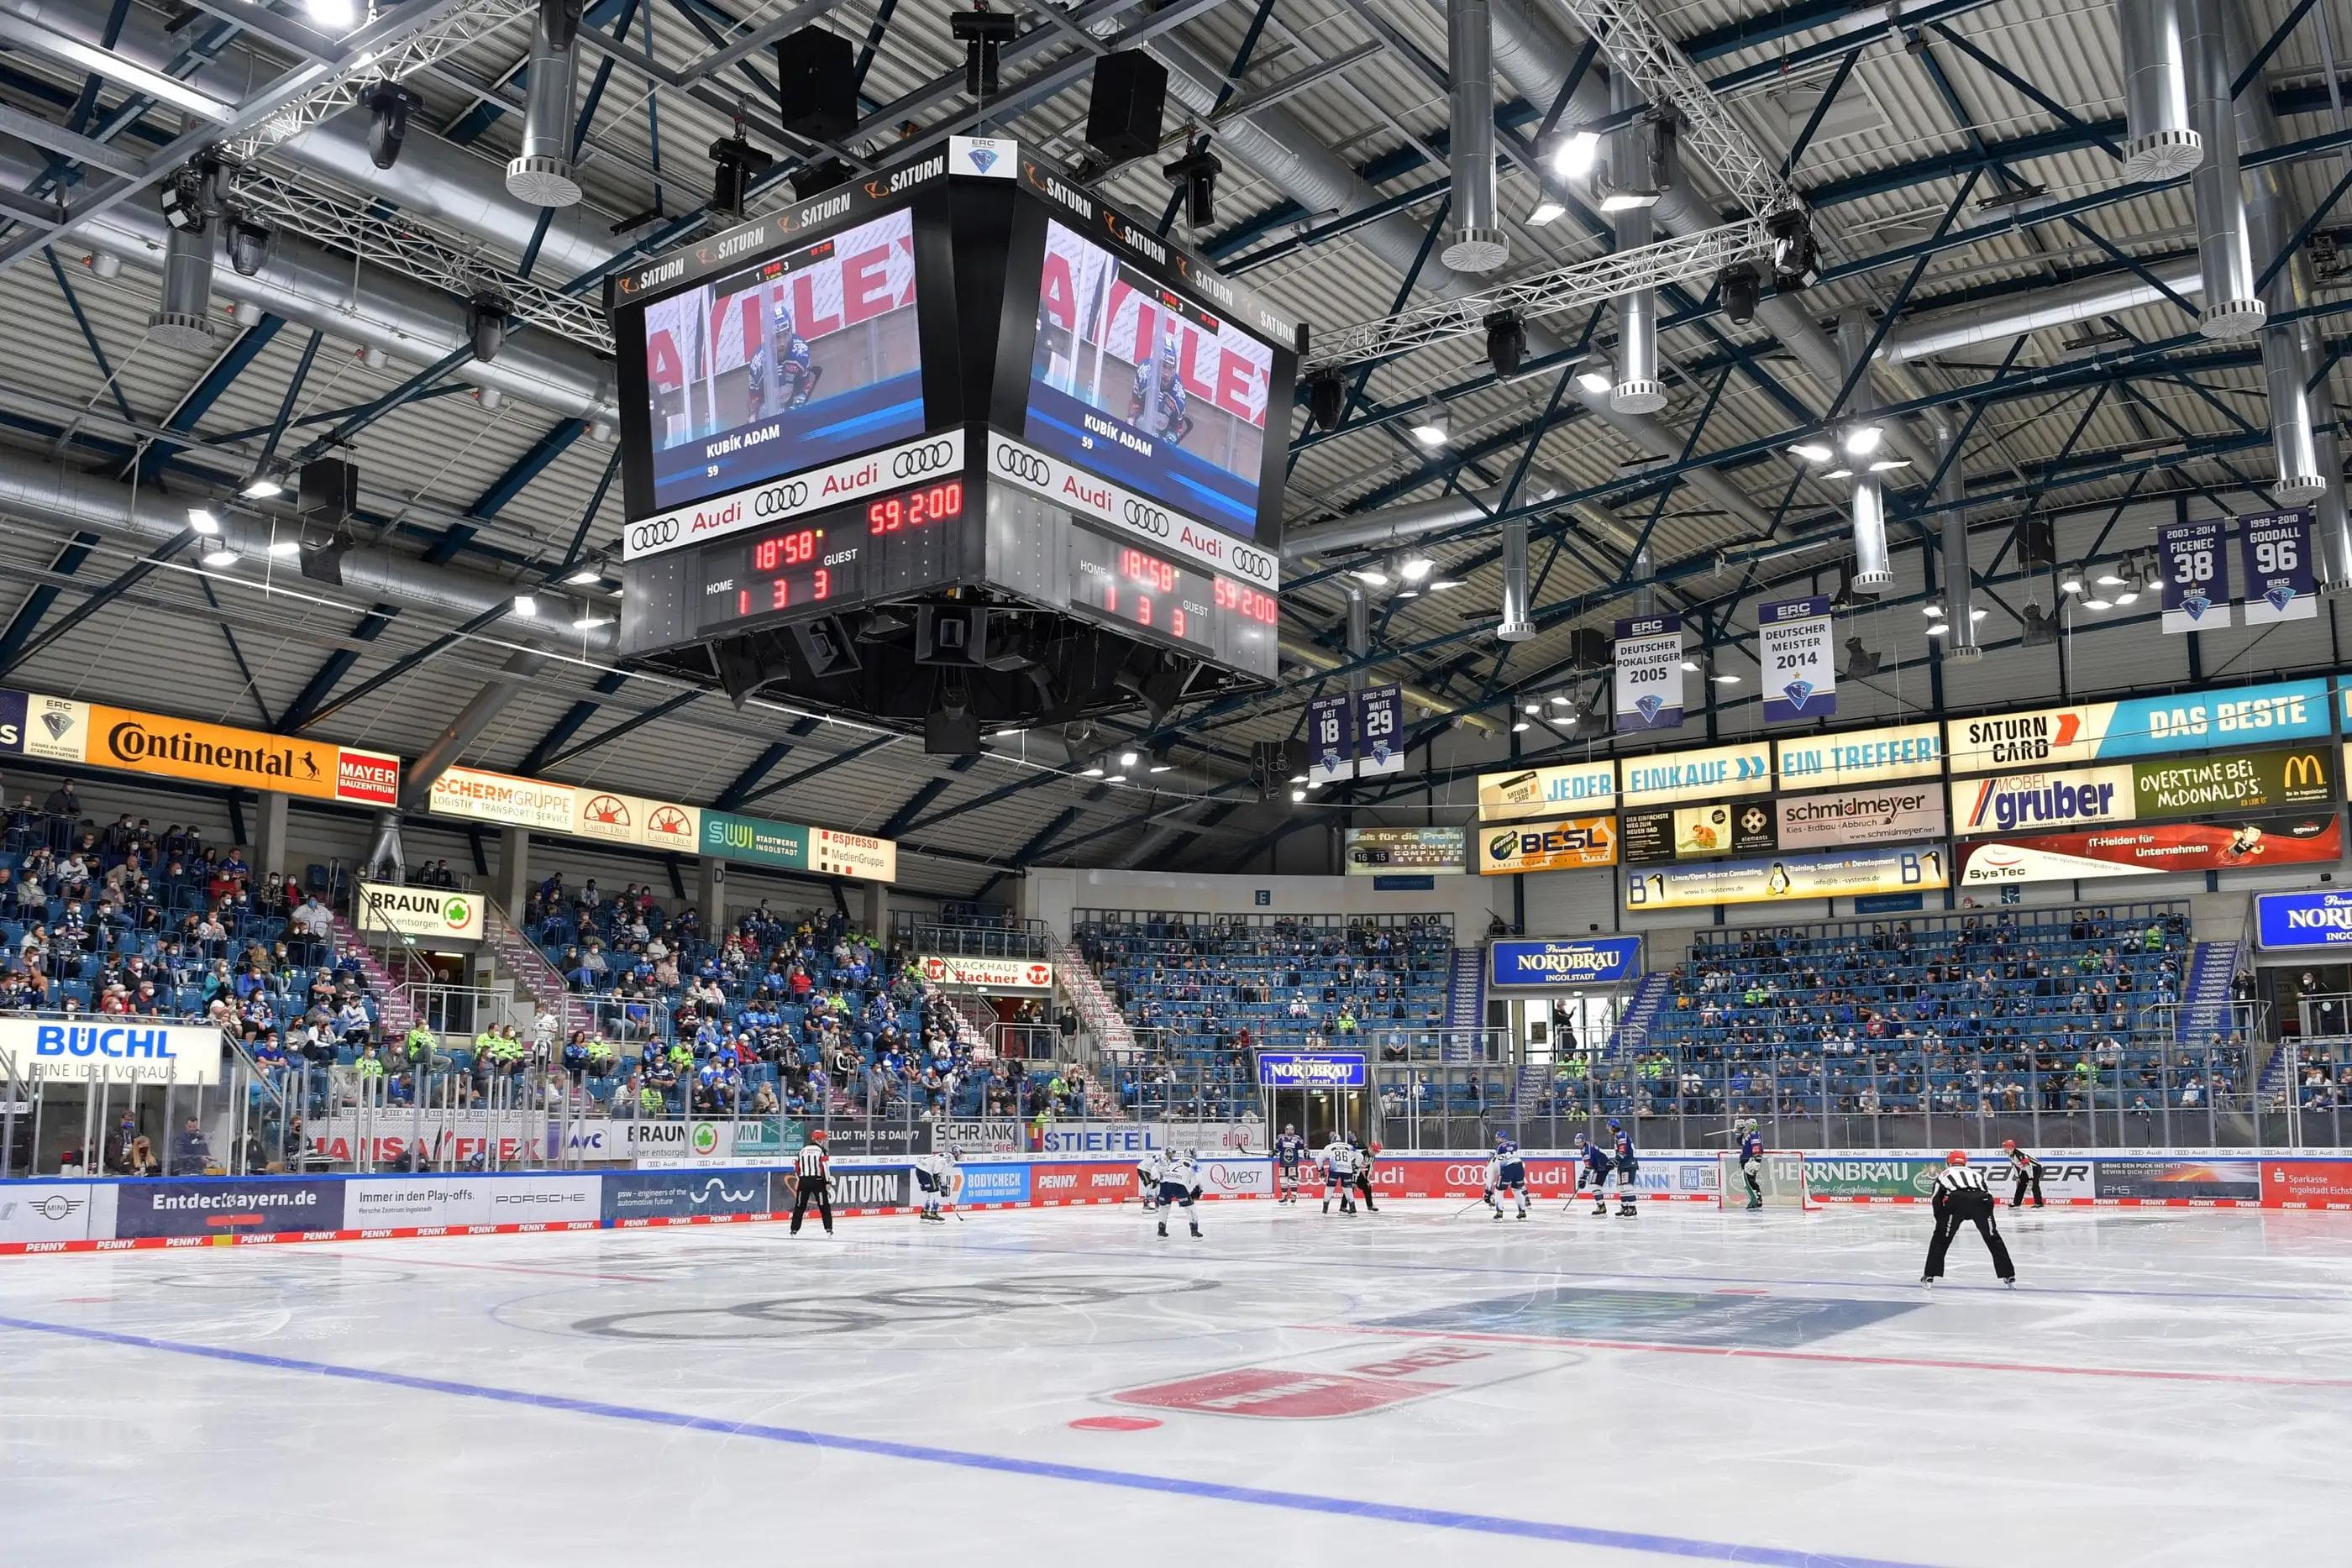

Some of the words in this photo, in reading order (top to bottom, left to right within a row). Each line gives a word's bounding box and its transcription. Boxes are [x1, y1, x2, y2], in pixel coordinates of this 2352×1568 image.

[890, 155, 943, 193] SATURN
[1046, 176, 1091, 219] SATURN
[801, 193, 851, 228] SATURN
[718, 227, 764, 260] SATURN
[640, 258, 684, 290] SATURN
[706, 434, 742, 459] KUBÍK
[743, 424, 780, 448] ADAM
[1082, 436, 1093, 449] 59
[1084, 414, 1119, 443] KUBÍK
[1119, 434, 1152, 458] ADAM
[707, 465, 719, 478] 59
[821, 463, 878, 497] Audi
[1063, 476, 1113, 512] Audi
[691, 501, 742, 533] Audi
[869, 500, 900, 534] 59
[909, 483, 962, 524] 2:00
[1180, 527, 1222, 559] Audi
[2250, 527, 2301, 543] GOODALL
[2170, 538, 2214, 553] FICENEC
[823, 548, 858, 567] GUEST
[2255, 540, 2298, 574] 96
[1080, 560, 1106, 577] HOME
[2173, 550, 2214, 584] 38
[706, 579, 733, 596] HOME
[814, 569, 830, 600] 3
[2266, 578, 2291, 586] ERC
[773, 579, 788, 608] 3
[1105, 586, 1116, 611] 1
[2183, 588, 2206, 596] ERC
[739, 590, 748, 615] 1
[1139, 597, 1152, 625] 3
[1183, 600, 1209, 618] GUEST
[1777, 602, 1811, 616] ERC
[1631, 620, 1663, 633] ERC
[1766, 624, 1826, 640] DEUTSCHER
[1620, 641, 1676, 655] DEUTSCHER
[1772, 637, 1821, 653] MEISTER
[1617, 652, 1681, 668] POKALSIEGER
[1777, 651, 1818, 670] 2014
[1630, 668, 1667, 684] 2005
[46, 700, 72, 710] ERC
[1368, 700, 1390, 711] WAITE
[1322, 709, 1336, 720] AST
[2150, 710, 2208, 740] DAS
[2217, 695, 2307, 732] BESTE
[1320, 718, 1340, 744] 18
[1368, 710, 1394, 737] 29
[1969, 716, 2048, 745] SATURN
[108, 721, 293, 779] Continental
[1783, 750, 1822, 778] EIN
[1830, 736, 1940, 771] TREFFER!
[1992, 738, 2049, 763] CARD
[340, 761, 396, 784] MAYER
[1631, 760, 1728, 794] EINKAUF
[339, 779, 396, 796] BAUZENTRUM
[1547, 774, 1612, 801] JEDER
[433, 796, 474, 809] LOGISTIK
[481, 802, 529, 818] TRANSPORT
[537, 811, 570, 824] SERVICE
[1786, 794, 1925, 822] schmidmeyer
[1995, 780, 2114, 830] gruber
[1786, 826, 1803, 834] Kies
[1808, 824, 1836, 832] Erdbau
[1841, 820, 1877, 829] Abbruch
[757, 835, 798, 848] STADTWERKE
[832, 832, 879, 850] espresso
[1378, 832, 1398, 841] für
[1521, 828, 1608, 854] BESL
[2088, 837, 2136, 847] IT-Helden
[2139, 835, 2155, 844] für
[756, 844, 798, 857] INGOLSTADT
[832, 849, 885, 867] MedienGruppe
[1357, 853, 1368, 862] 16
[1376, 853, 1386, 862] 15
[2136, 843, 2208, 858] Unternehmen
[1817, 862, 1843, 871] Support
[1852, 857, 1896, 868] Development
[715, 868, 724, 884] D
[1671, 873, 1707, 882] Linux/Open
[1707, 871, 1729, 879] Source
[1970, 867, 2026, 880] SysTec
[370, 892, 440, 915] BRAUN
[1260, 893, 1266, 904] E
[396, 917, 438, 930] entsorgen
[955, 960, 1019, 973] BACKHAUS
[1517, 951, 1620, 973] NORDBRÄU
[955, 970, 1018, 984] Hackner
[1545, 973, 1596, 982] INGOLSTADT
[35, 1025, 177, 1059] BÜCHL
[1270, 1063, 1353, 1079] NORDBRÄU
[877, 1130, 886, 1140] IS
[936, 1124, 1014, 1141] SCHRANK
[1044, 1132, 1162, 1151] STIEFEL
[1334, 1151, 1348, 1162] 86
[969, 1172, 1021, 1188] BODYCHECK
[1772, 1162, 1908, 1182] HERRNBRÄU
[2288, 1175, 2328, 1184] Sparkasse
[1683, 1177, 1698, 1187] FAN
[2289, 1186, 2328, 1195] Ingolstadt
[360, 1191, 393, 1204] Immer
[395, 1191, 404, 1202] in
[407, 1190, 425, 1202] den
[428, 1189, 475, 1203] Play-offs.
[496, 1193, 585, 1204] PORSCHE
[617, 1191, 632, 1199] psw
[638, 1188, 668, 1198] engineers
[46, 1204, 65, 1212] MINI
[381, 1206, 404, 1214] Zentrum
[406, 1205, 433, 1214] Ingolstadt
[617, 1198, 653, 1207] automotive
